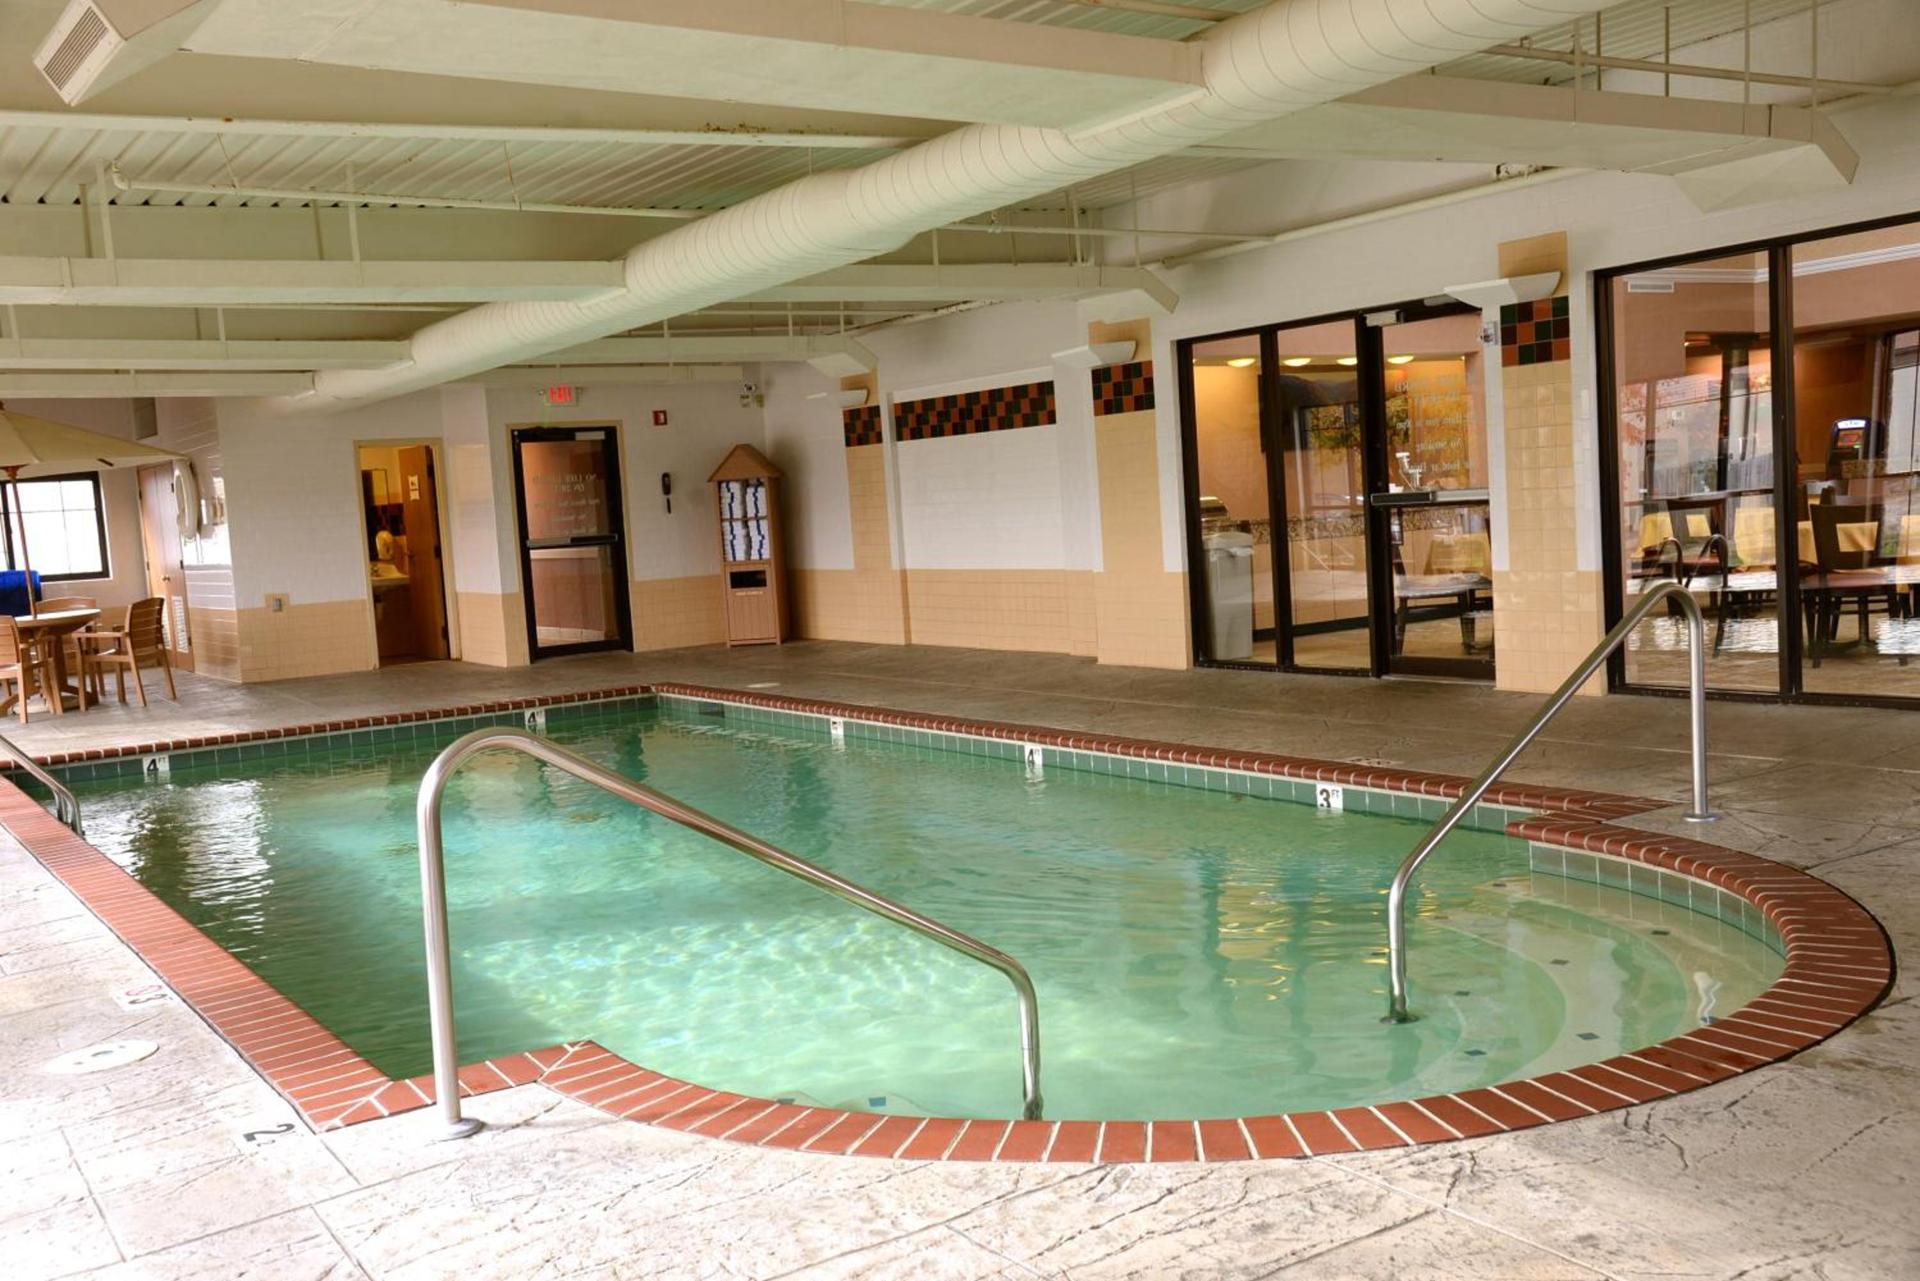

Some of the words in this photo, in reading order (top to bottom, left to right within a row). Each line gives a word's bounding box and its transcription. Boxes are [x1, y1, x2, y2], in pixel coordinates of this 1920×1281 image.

[147, 758, 159, 771] 4
[1027, 748, 1035, 764] 4
[1320, 788, 1331, 808] 3
[243, 1123, 296, 1142] 2
